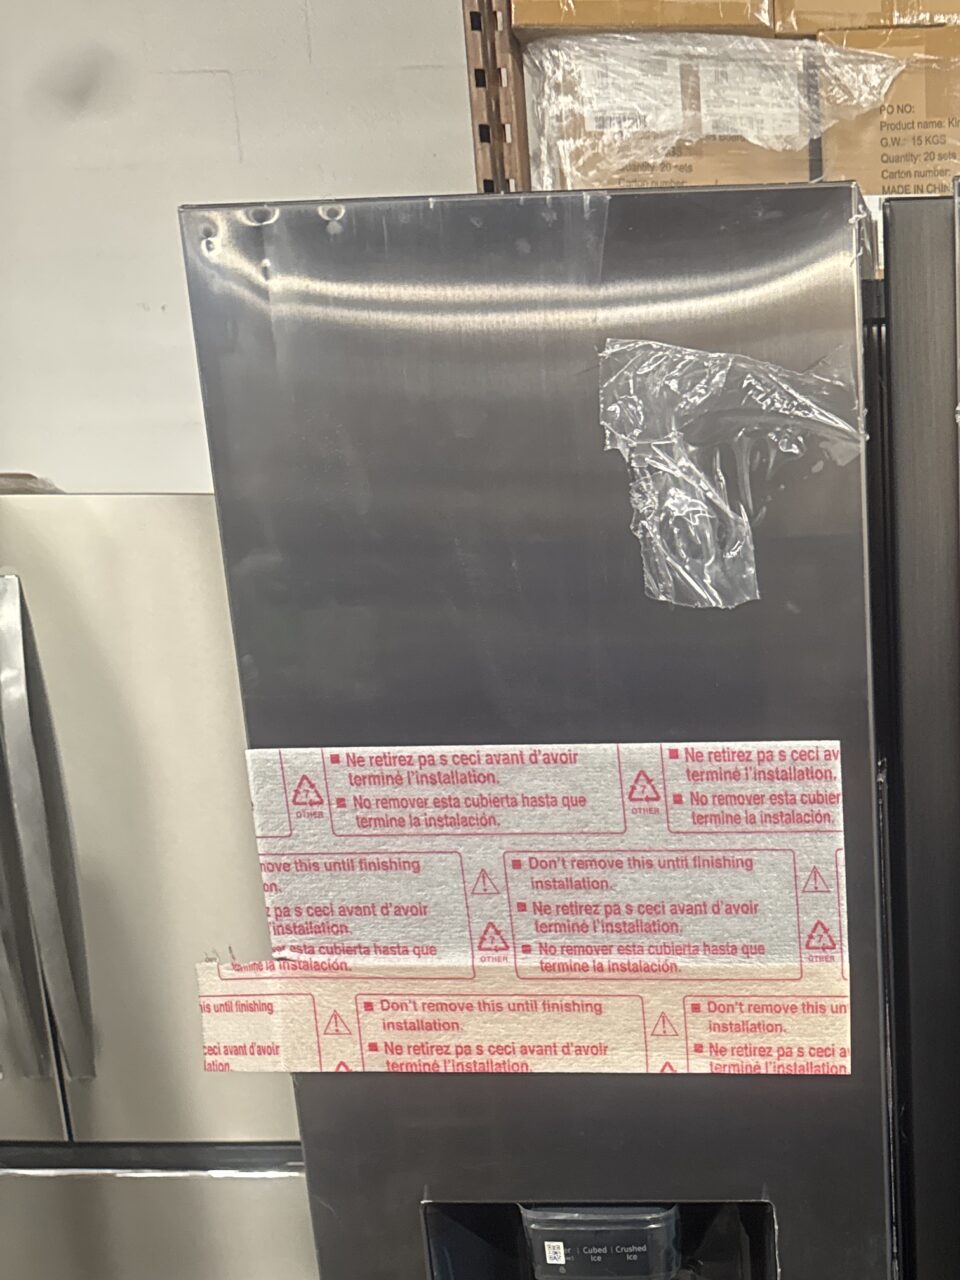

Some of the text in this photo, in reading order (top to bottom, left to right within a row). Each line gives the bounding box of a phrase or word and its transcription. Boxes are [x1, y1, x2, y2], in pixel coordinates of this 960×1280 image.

[896, 103, 915, 114] NO:
[879, 120, 915, 131] Product
[917, 119, 945, 130] name:
[912, 136, 923, 146] 15
[924, 135, 947, 145] KGS
[880, 152, 922, 164] Quantity:
[923, 151, 936, 162] 20
[881, 168, 912, 180] Carton
[881, 182, 952, 195] MADE IN CHIN
[345, 752, 366, 767] Ne
[368, 752, 415, 767] retirez
[451, 751, 482, 766] ceci
[485, 751, 525, 766] avant
[528, 750, 578, 765] d'avoir
[348, 771, 404, 785] terminé
[686, 767, 741, 781] terminé
[352, 794, 587, 811] No remover esta cubierta hasta que
[355, 814, 501, 827] termine la instalación.
[691, 811, 834, 825] termine la instalación.
[528, 856, 753, 872] Don't remove this until finishing
[531, 877, 613, 890] installation.
[379, 998, 603, 1015] Don't remove this until finishing
[382, 1019, 463, 1031] installation.
[582, 1246, 608, 1255] Cubed
[615, 1244, 647, 1254] Crushed
